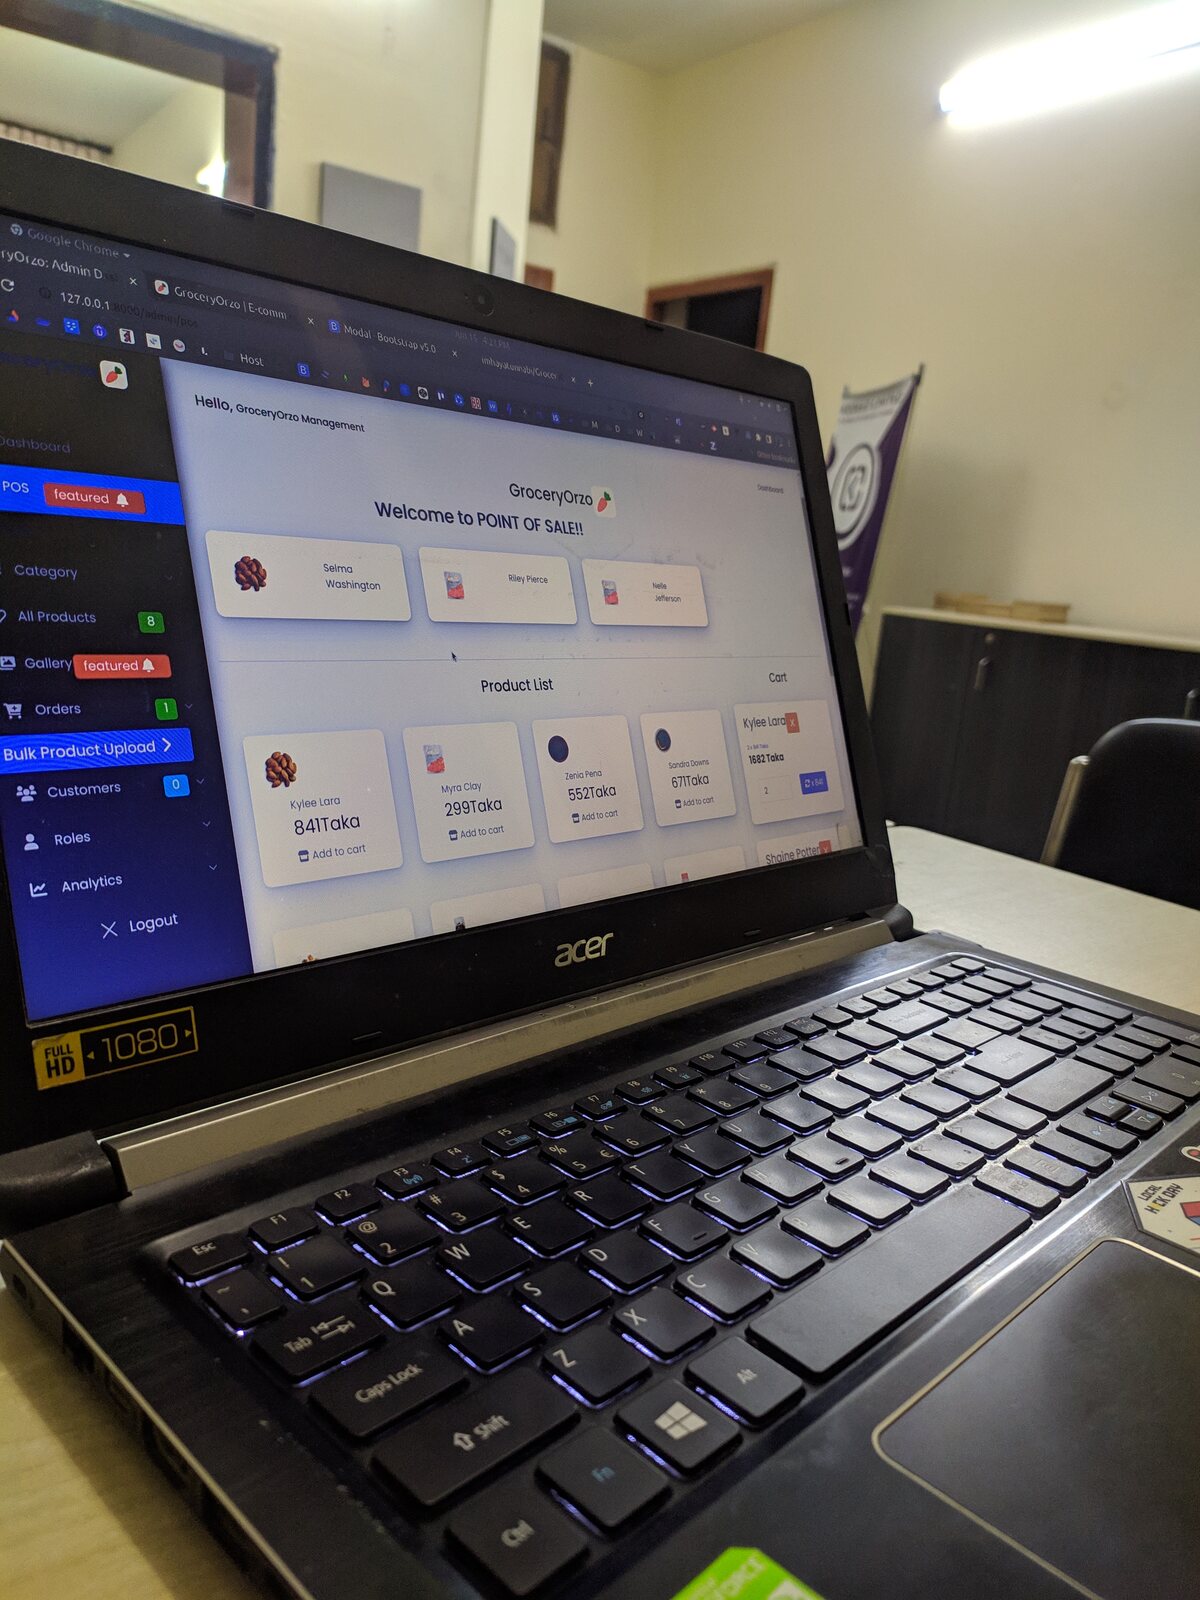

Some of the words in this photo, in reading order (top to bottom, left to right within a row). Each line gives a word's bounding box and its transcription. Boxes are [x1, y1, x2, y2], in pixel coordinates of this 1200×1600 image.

[27, 227, 71, 249] Google
[74, 239, 119, 259] Chrome
[52, 259, 91, 278] Admin
[174, 286, 241, 311] GroceryOrzo
[248, 303, 288, 320] E-comm
[240, 353, 264, 367] Host
[194, 394, 234, 413] Hello,
[236, 404, 299, 422] GroceryOrzo
[301, 414, 365, 432] Management
[2, 480, 29, 494] POS
[54, 488, 110, 504] featured
[509, 482, 593, 507] GroceryOrzo
[375, 501, 454, 524] Welcome
[457, 510, 474, 526] to
[477, 511, 519, 531] POINT
[524, 517, 541, 532] OF
[545, 519, 584, 536] SALE!!
[14, 564, 78, 581] Category
[323, 563, 353, 574] Selma
[326, 579, 381, 592] Washington
[508, 573, 525, 584] Riley
[526, 574, 548, 584] Pierce
[18, 610, 34, 622] All
[38, 610, 97, 623] Products
[147, 615, 155, 627] 8
[24, 657, 72, 673] Gallery
[83, 660, 139, 672] featured
[481, 678, 531, 693] Product
[533, 677, 554, 691] List
[768, 672, 788, 683] Cart
[35, 703, 81, 716] Orders
[163, 702, 169, 713] 1
[742, 717, 766, 731] Kylee
[768, 716, 786, 727] Lara
[4, 746, 37, 762] Bulk
[41, 743, 100, 759] Product
[104, 740, 156, 759] Upload
[668, 760, 690, 769] Sandra
[690, 758, 709, 767] Downs
[748, 754, 765, 765] 1682
[766, 753, 784, 763] Taka
[564, 771, 584, 781] Zenia
[585, 770, 602, 779] Pena
[671, 774, 709, 788] 671Taka
[47, 782, 121, 798] Customers
[171, 779, 180, 790] 0
[441, 784, 462, 795] Myra
[463, 782, 482, 793] Clay
[568, 785, 617, 801] 552Taka
[290, 798, 317, 811] Kylee
[319, 796, 341, 808] Lara
[444, 798, 502, 817] 299Taka
[682, 799, 695, 807] Add
[695, 798, 702, 806] to
[702, 796, 714, 805] cart
[581, 812, 595, 821] Add
[596, 811, 604, 819] to
[604, 809, 618, 818] cart
[294, 814, 361, 836] 841Taka
[460, 829, 476, 839] Add
[477, 827, 487, 837] to
[488, 825, 504, 836] cart
[54, 832, 91, 845] Roles
[312, 849, 332, 860] Add
[334, 848, 345, 857] to
[346, 844, 366, 856] cart
[765, 850, 795, 865] Shaine
[796, 845, 820, 858] Potter
[62, 874, 123, 893] Analytics
[129, 913, 178, 933] Logout
[554, 932, 614, 968] acer
[101, 1023, 178, 1063] 1080
[44, 1043, 74, 1060] FULL
[45, 1056, 76, 1079] HD
[666, 1066, 678, 1074] F9
[627, 1080, 641, 1088] F8
[587, 1094, 599, 1103] F7
[544, 1111, 558, 1120] F6
[498, 1128, 512, 1137] F5
[626, 1138, 639, 1147] 6
[679, 1144, 696, 1153] Y
[447, 1147, 462, 1157] F4
[393, 1167, 409, 1177] F3
[572, 1161, 587, 1170] 5
[629, 1164, 646, 1175] T
[334, 1189, 351, 1200] F2
[517, 1184, 530, 1194] 4
[574, 1190, 593, 1202] R
[1137, 1184, 1162, 1202] LOCAL
[1162, 1182, 1184, 1199] DAY
[703, 1192, 721, 1204] G
[269, 1213, 288, 1226] F1
[451, 1211, 467, 1222] 3
[513, 1216, 532, 1230] E
[358, 1220, 377, 1234] @
[648, 1219, 663, 1232] F
[191, 1241, 217, 1256] Esc
[379, 1242, 396, 1254] 2
[444, 1243, 471, 1260] W
[588, 1248, 608, 1262] D
[372, 1280, 396, 1296] Q
[523, 1281, 542, 1297] S
[686, 1274, 706, 1289] C
[623, 1308, 647, 1326] X
[453, 1318, 474, 1336] A
[284, 1336, 313, 1353] Tab
[552, 1349, 577, 1368] Z
[354, 1378, 392, 1403] Caps
[388, 1362, 424, 1386] Lock
[473, 1414, 511, 1441] Shift
